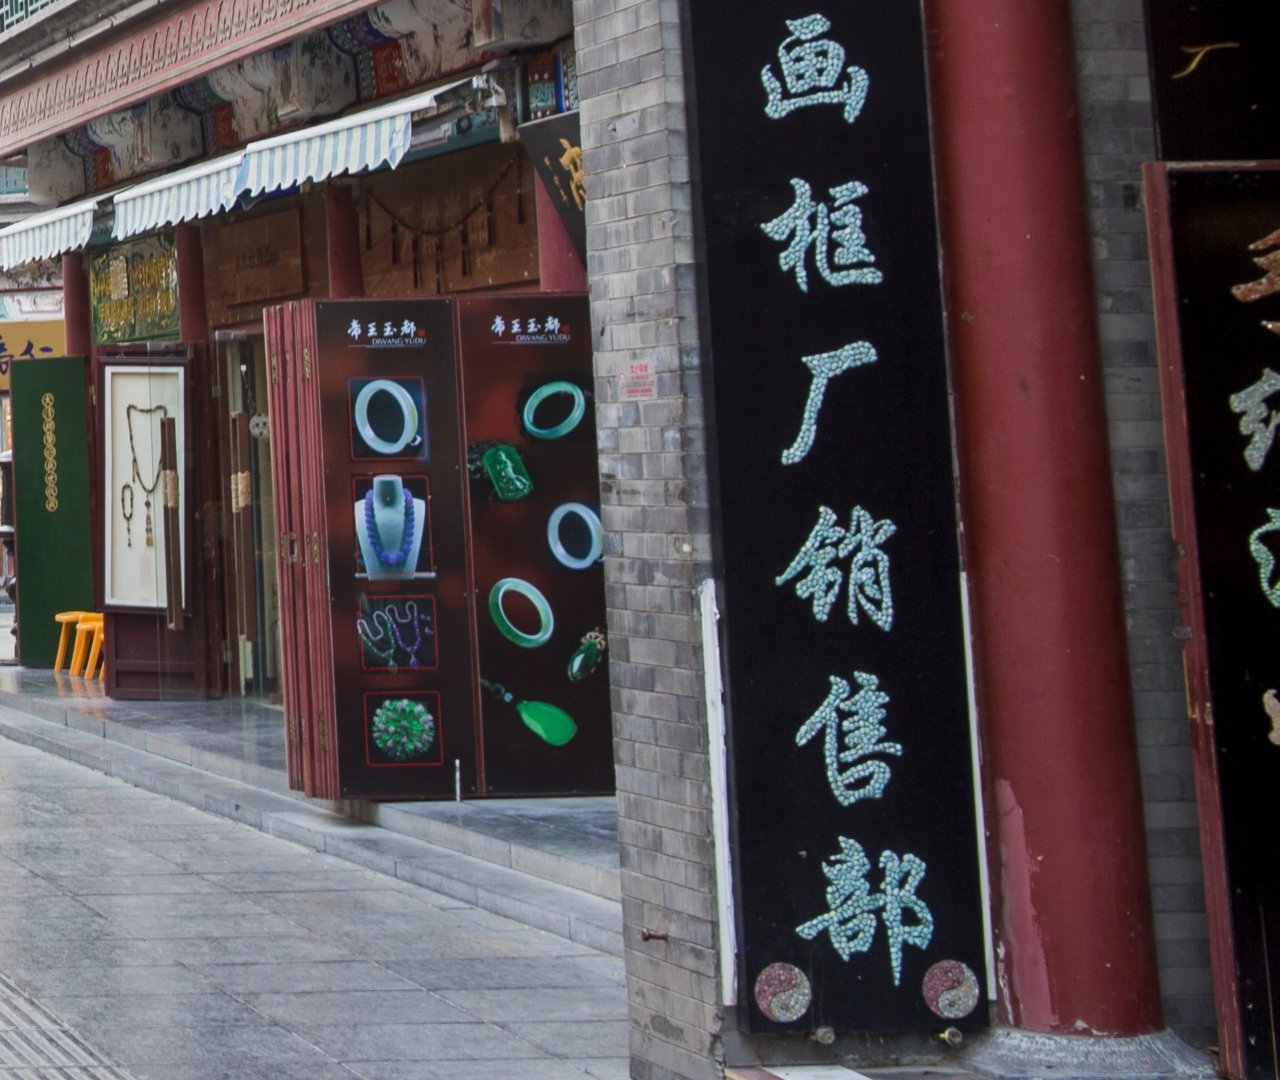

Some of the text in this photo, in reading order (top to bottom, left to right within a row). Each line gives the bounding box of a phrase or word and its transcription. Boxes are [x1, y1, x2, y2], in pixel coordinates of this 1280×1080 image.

[347, 319, 417, 341] 帝王玉都
[491, 315, 561, 337] 帝王玉都
[516, 334, 547, 342] DIWANG
